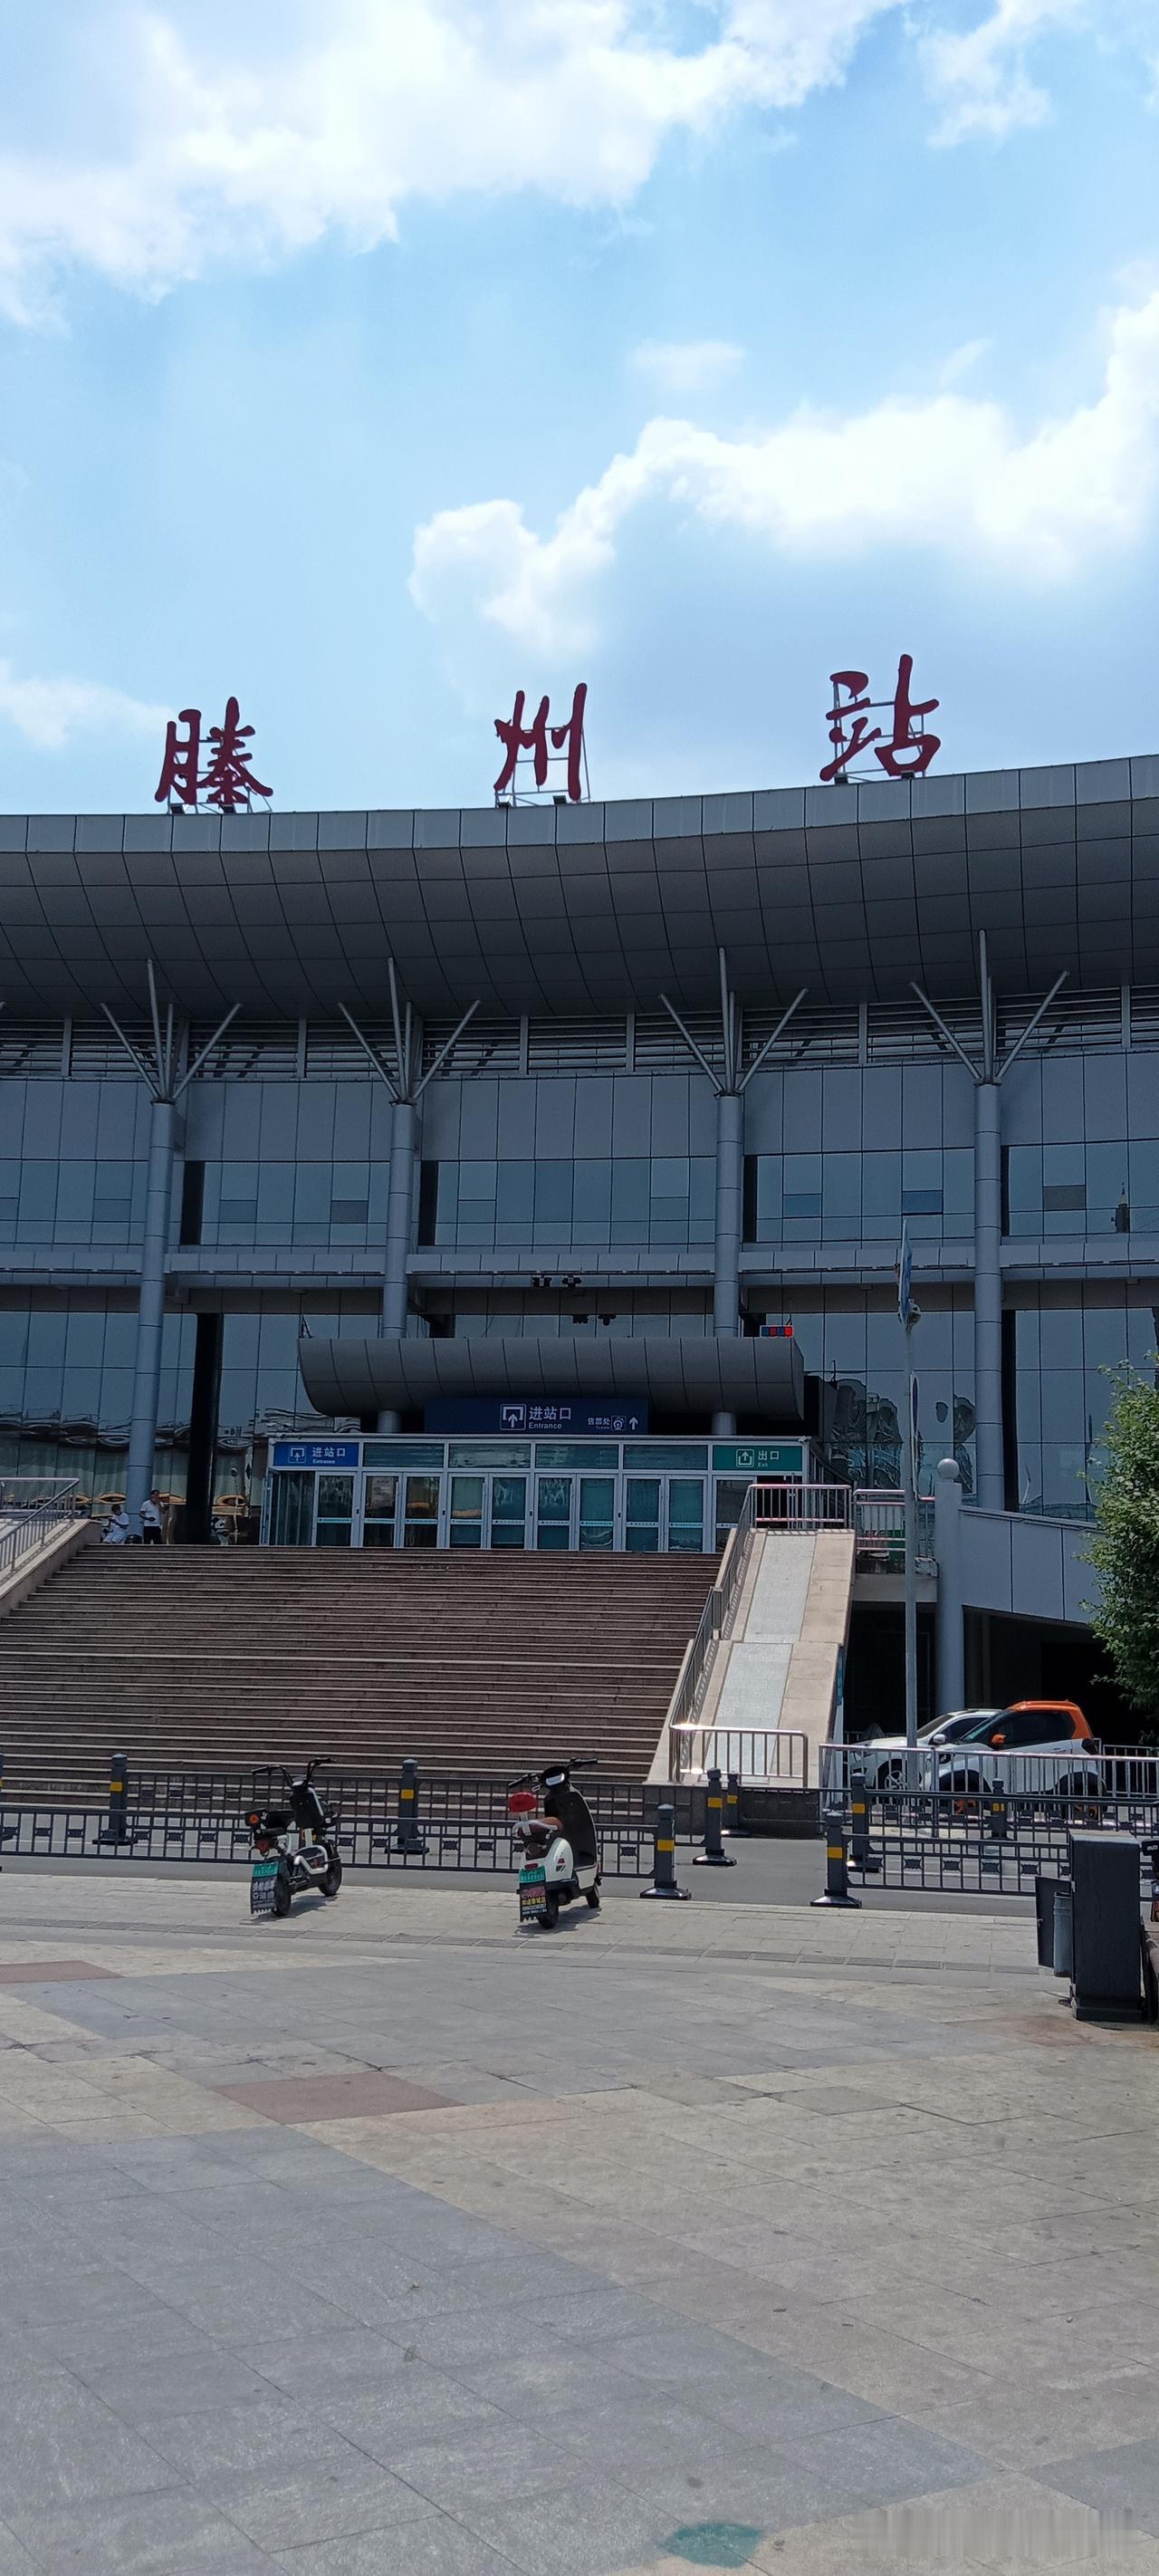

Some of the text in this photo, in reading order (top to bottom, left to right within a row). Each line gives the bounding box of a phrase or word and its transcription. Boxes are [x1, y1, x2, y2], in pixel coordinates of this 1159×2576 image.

[155, 654, 940, 804] 滕州站
[529, 1407, 571, 1420] 进站口
[311, 1447, 346, 1457] 进站口
[758, 1450, 780, 1461] 出口
